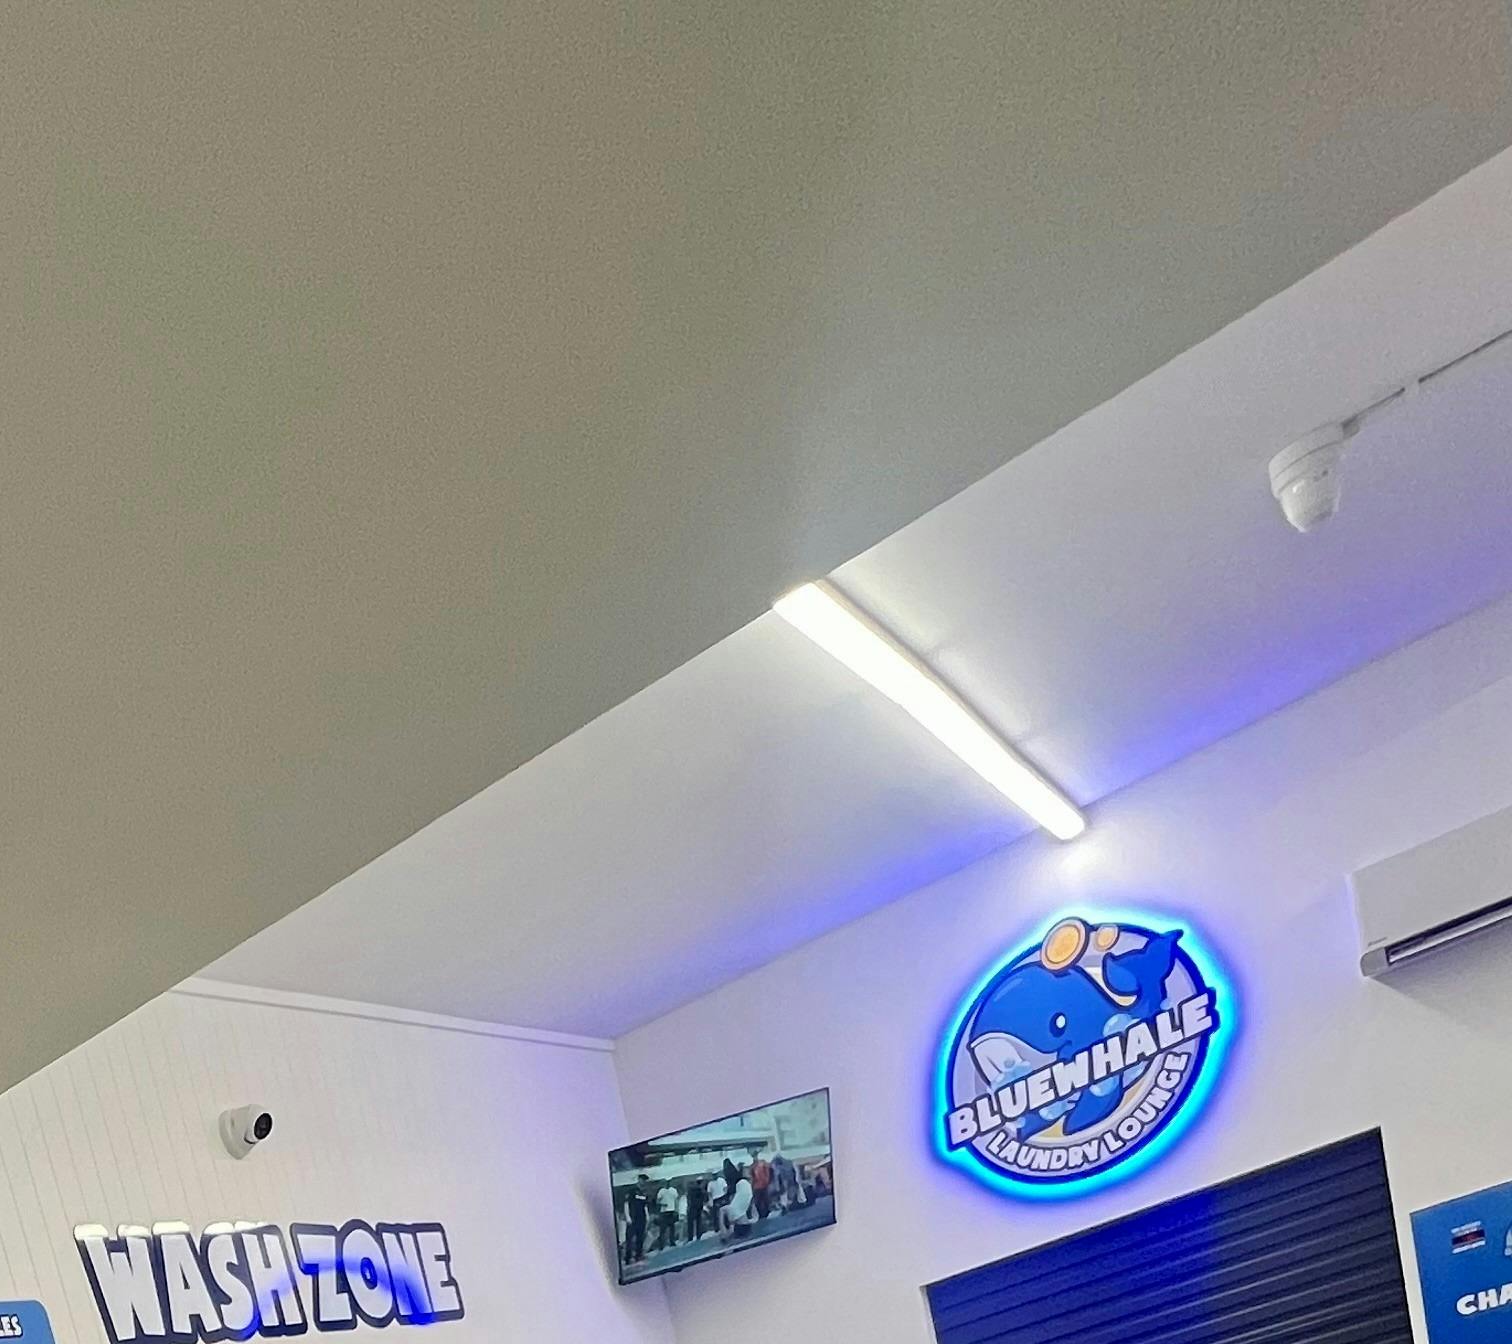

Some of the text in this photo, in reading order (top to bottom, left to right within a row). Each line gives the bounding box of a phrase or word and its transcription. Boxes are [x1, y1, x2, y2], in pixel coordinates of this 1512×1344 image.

[948, 992, 1213, 1146] BLUEWHALE
[986, 1051, 1190, 1171] LAUNDRY LOUNGE
[291, 1219, 465, 1329] ZONE
